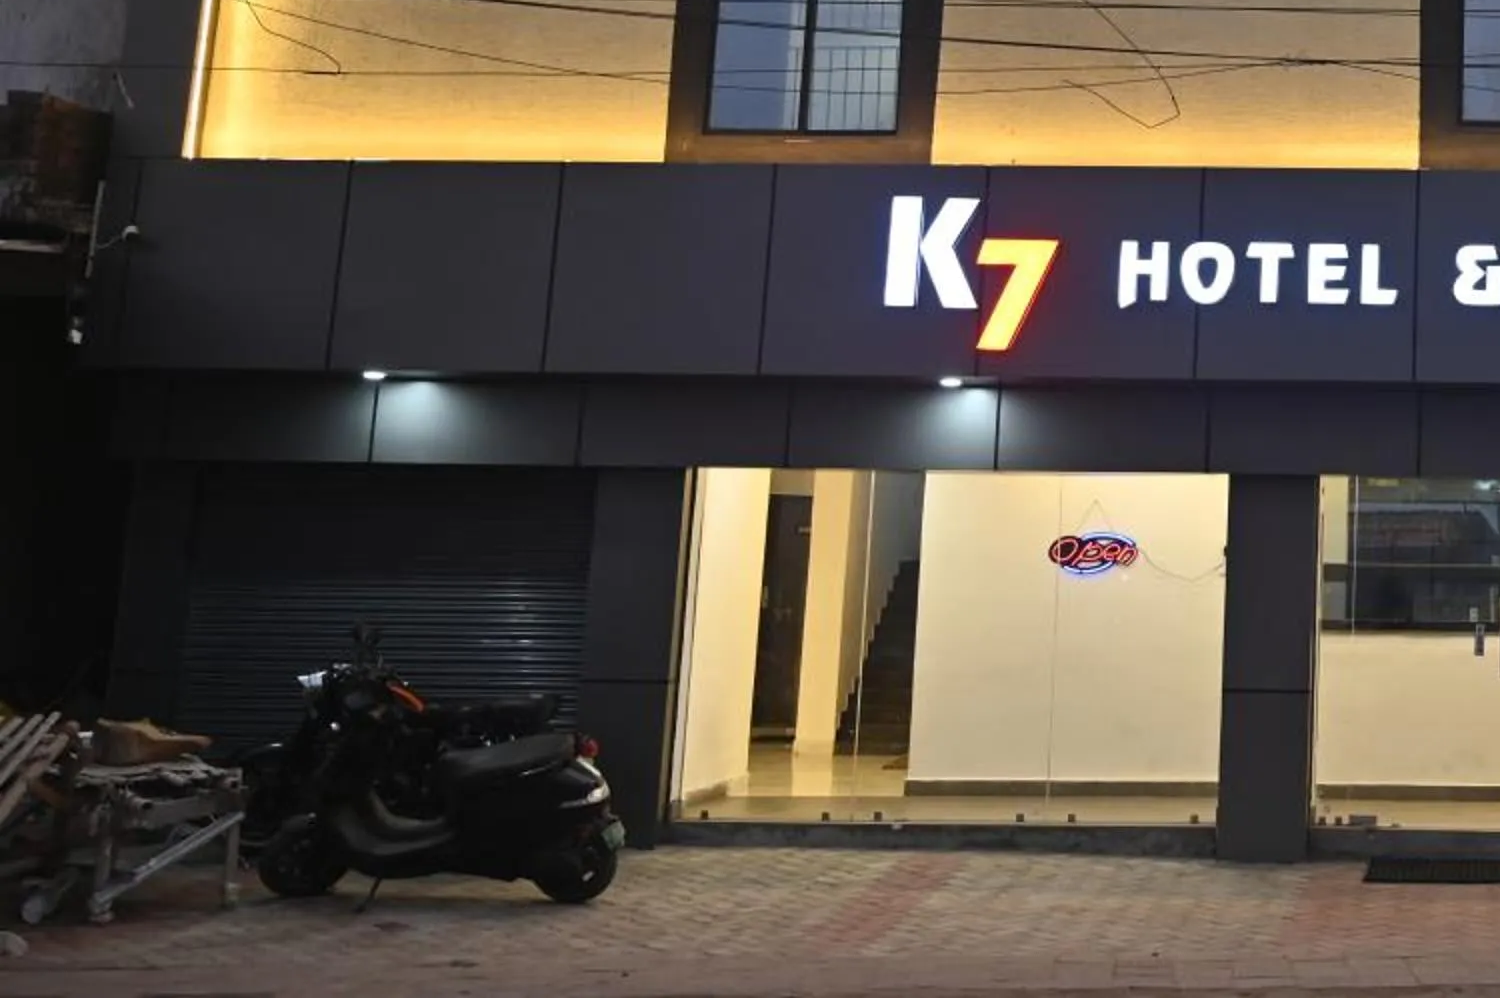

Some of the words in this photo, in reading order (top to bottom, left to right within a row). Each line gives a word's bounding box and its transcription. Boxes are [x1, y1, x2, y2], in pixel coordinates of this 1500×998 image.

[883, 195, 1060, 352] K7
[1118, 239, 1398, 309] HOTEL
[1049, 535, 1139, 568] Open
